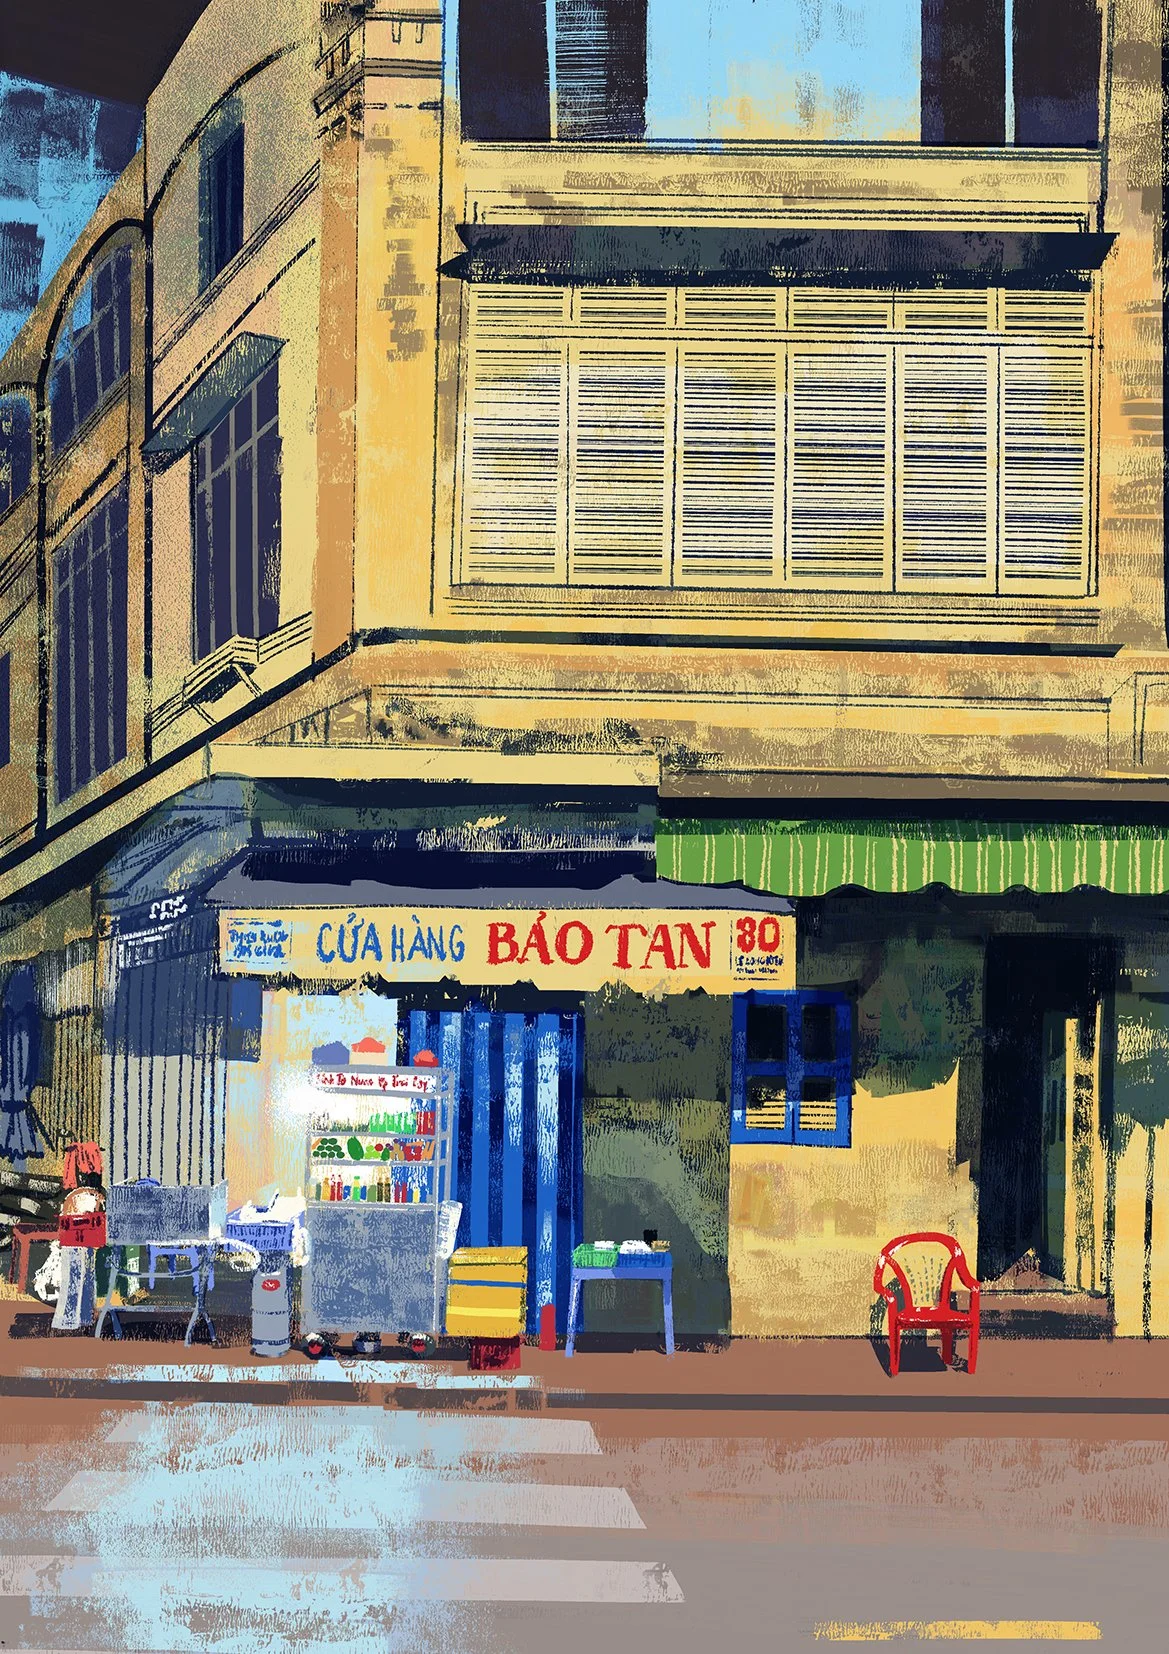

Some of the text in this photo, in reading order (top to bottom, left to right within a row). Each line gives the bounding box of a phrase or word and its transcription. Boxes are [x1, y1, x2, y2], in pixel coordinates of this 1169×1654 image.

[391, 914, 465, 963] HÀNG
[605, 921, 717, 970] TAN
[735, 915, 781, 954] 80
